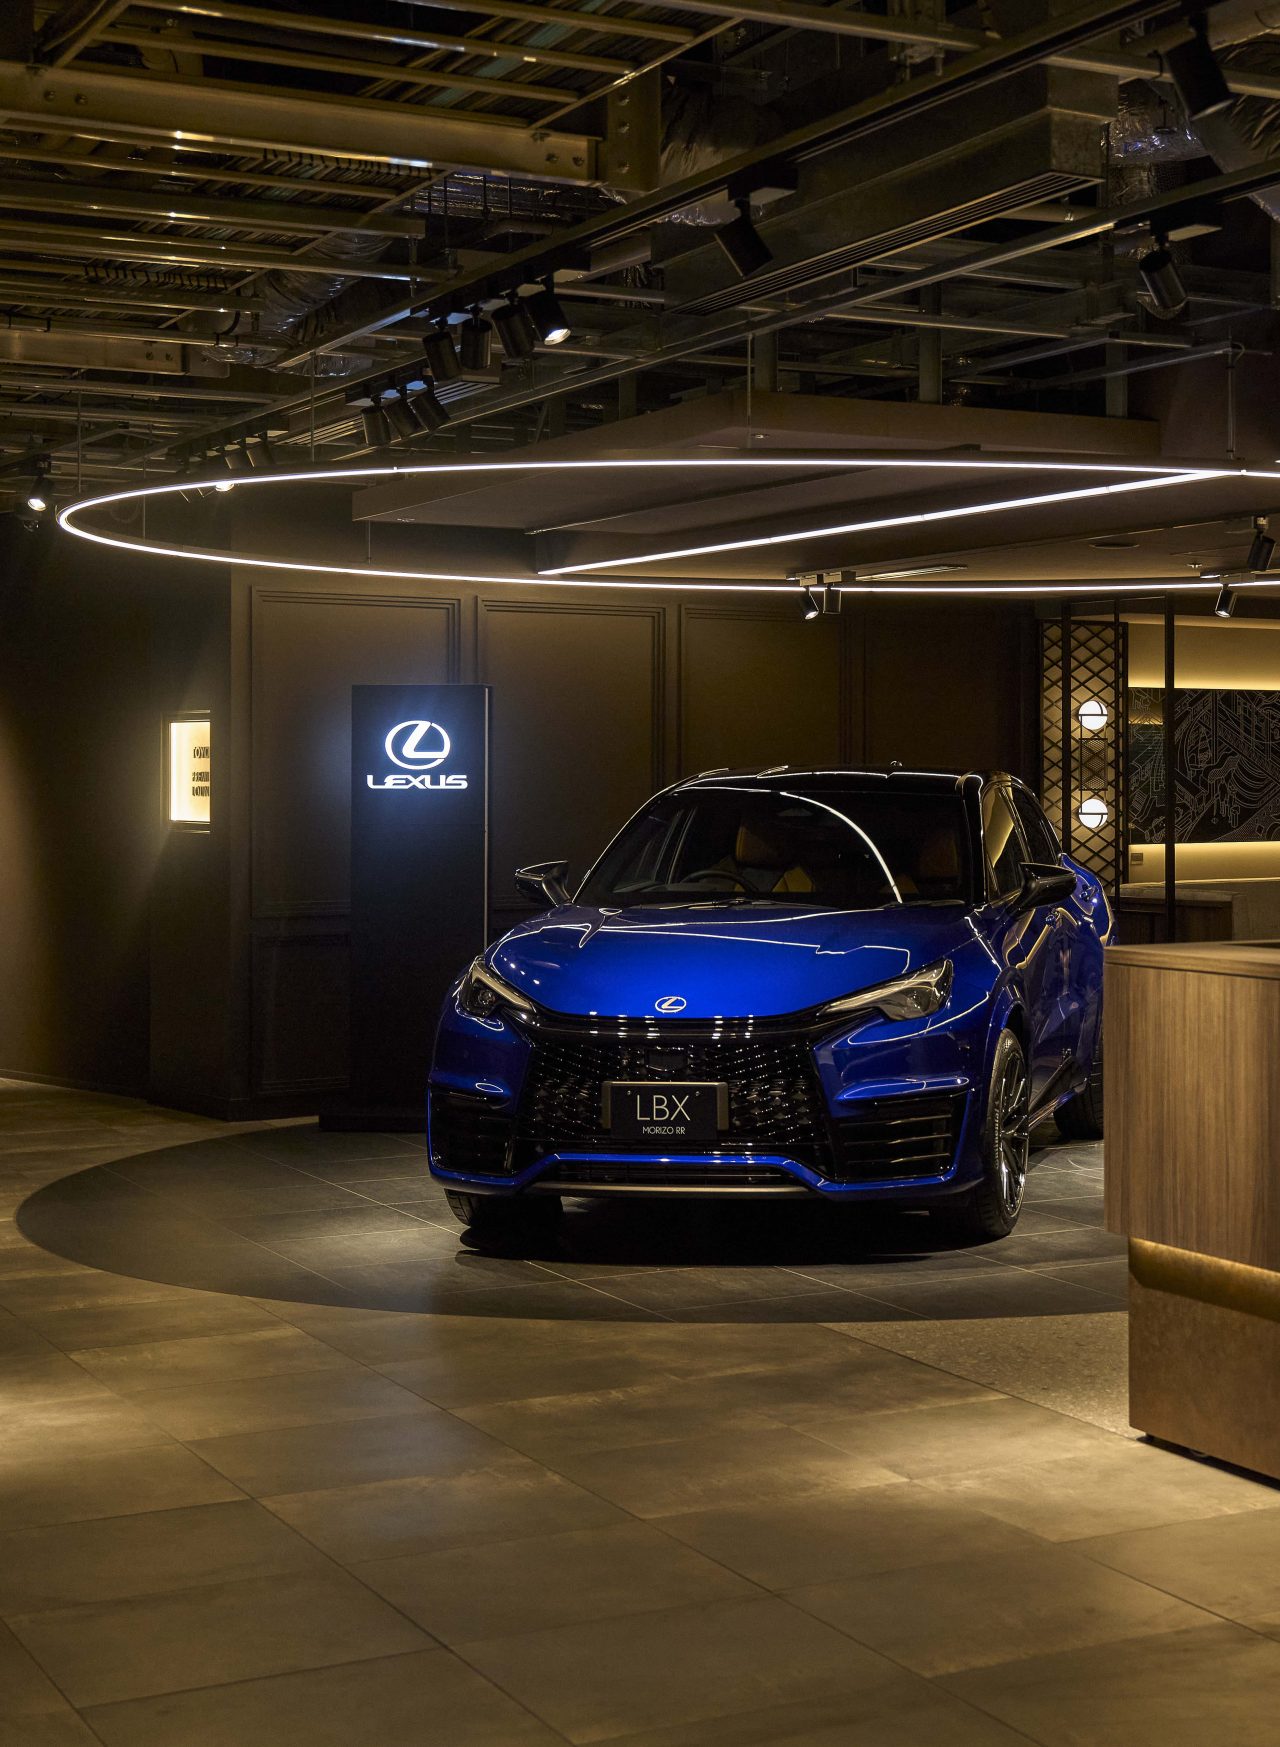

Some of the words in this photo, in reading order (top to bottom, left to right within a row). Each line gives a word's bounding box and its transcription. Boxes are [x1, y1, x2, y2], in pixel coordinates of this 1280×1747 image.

[366, 774, 469, 790] LEXUS
[636, 1094, 691, 1121] LBX
[642, 1126, 674, 1135] MORIZO
[675, 1126, 686, 1135] RR
